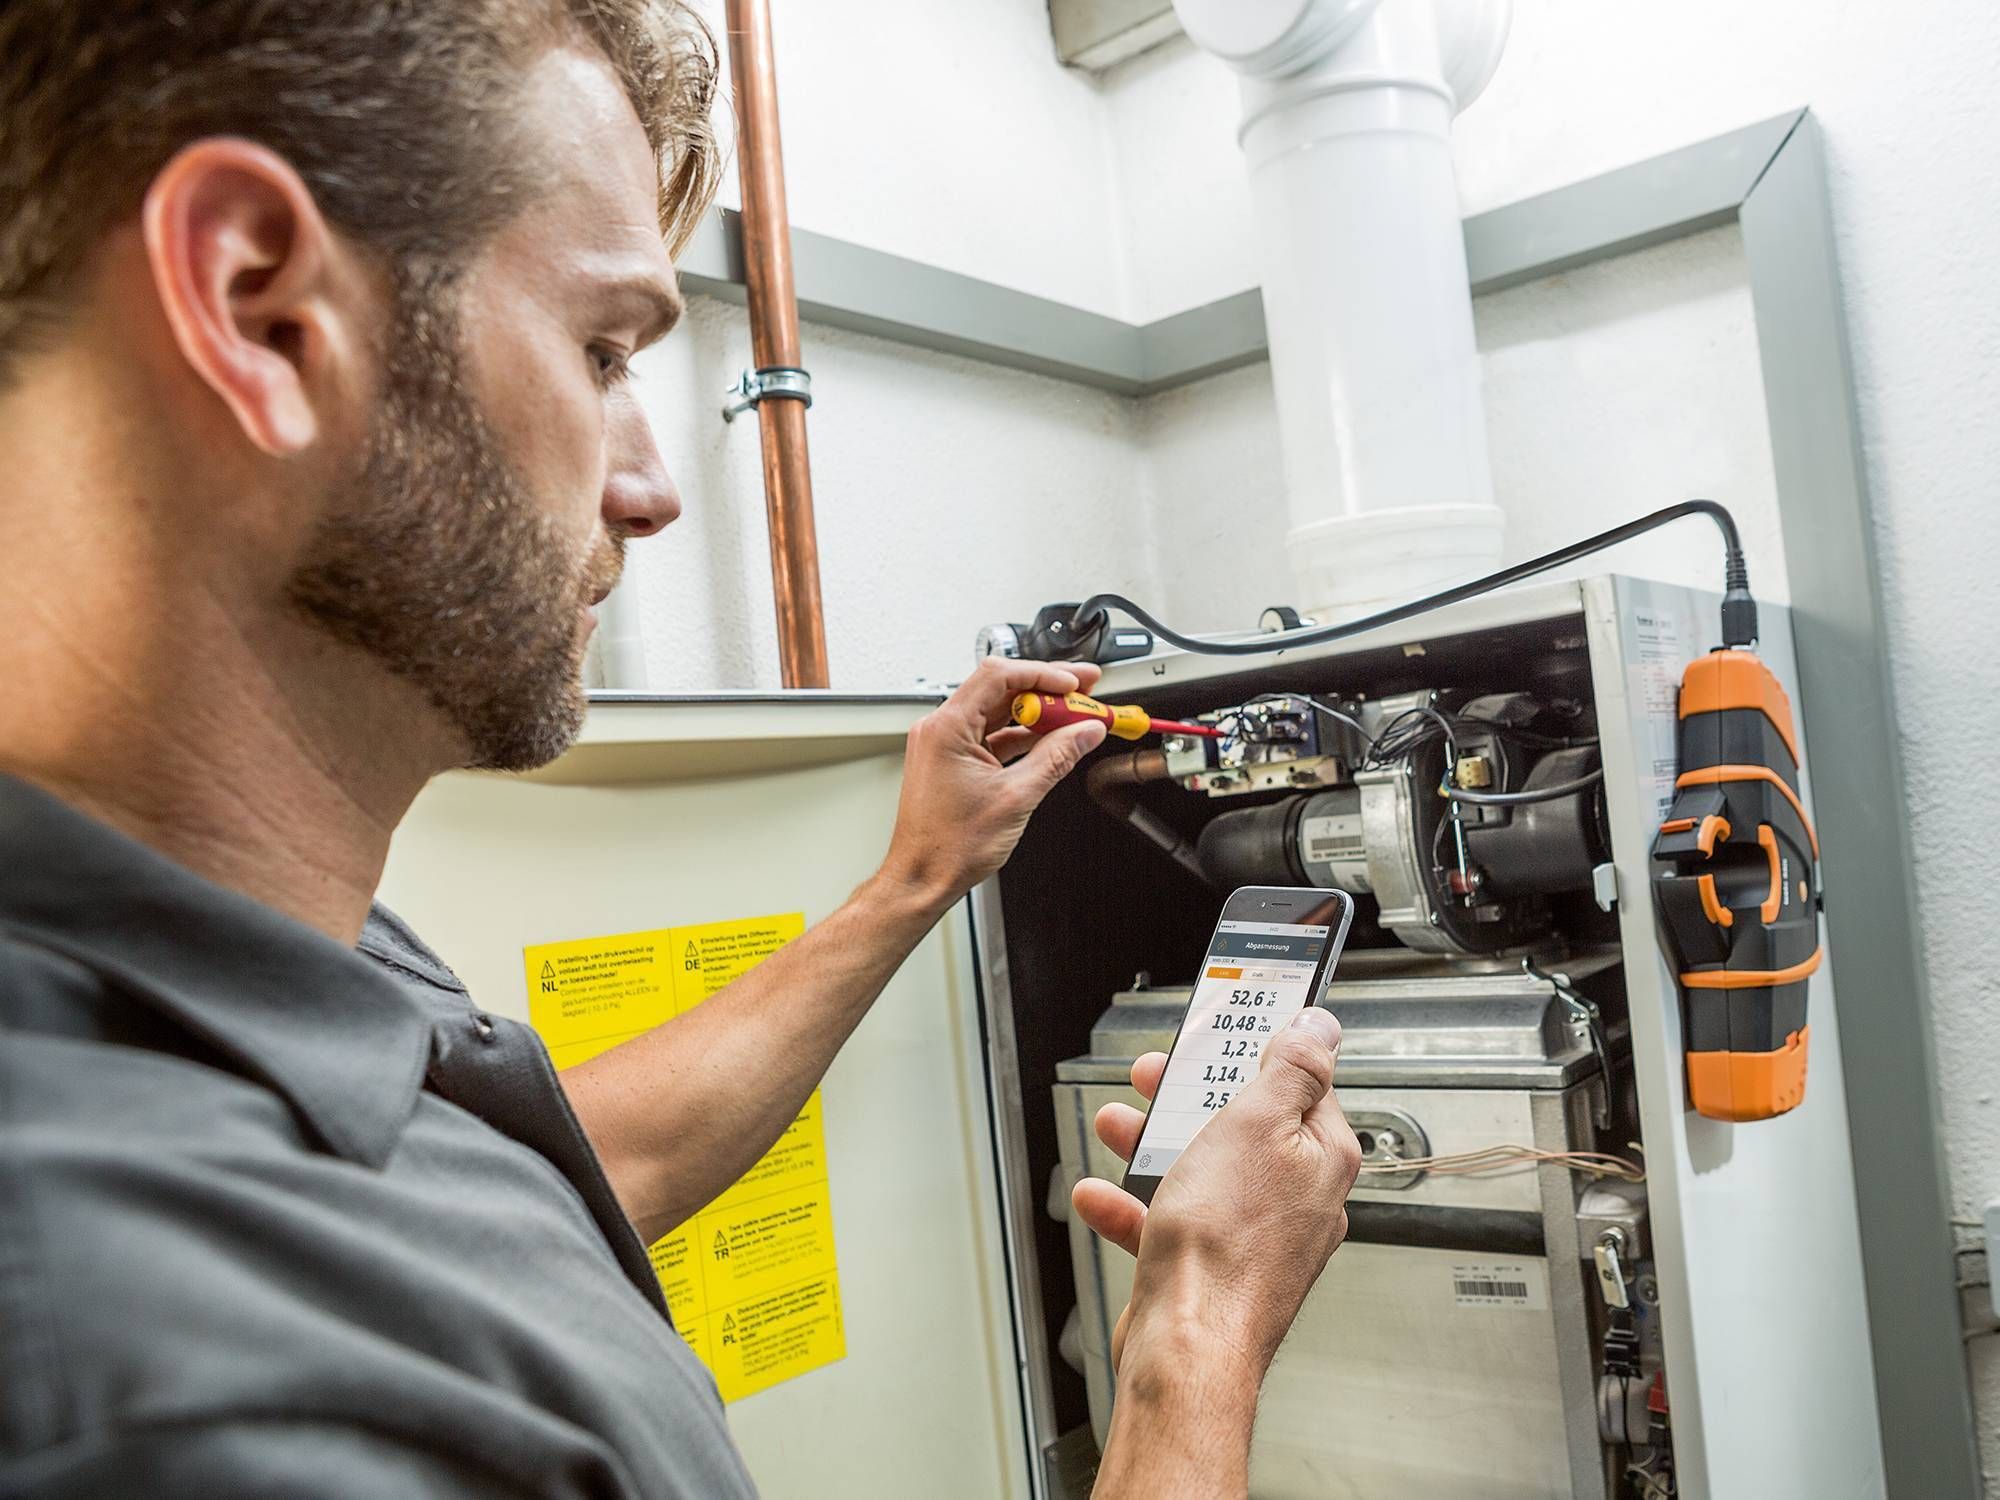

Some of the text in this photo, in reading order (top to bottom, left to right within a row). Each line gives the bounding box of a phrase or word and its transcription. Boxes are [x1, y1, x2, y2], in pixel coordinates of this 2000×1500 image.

[1245, 941, 1290, 952] Abgasmessung
[685, 958, 700, 971] DE
[541, 980, 559, 993] NL
[1229, 989, 1265, 1008] 52,6
[1211, 1013, 1256, 1033] 10,48
[1221, 1040, 1248, 1059] 1,2
[1249, 1051, 1258, 1059] qA
[1202, 1065, 1239, 1084] 1,14
[713, 1247, 730, 1261] TR
[722, 1333, 737, 1346] PL
